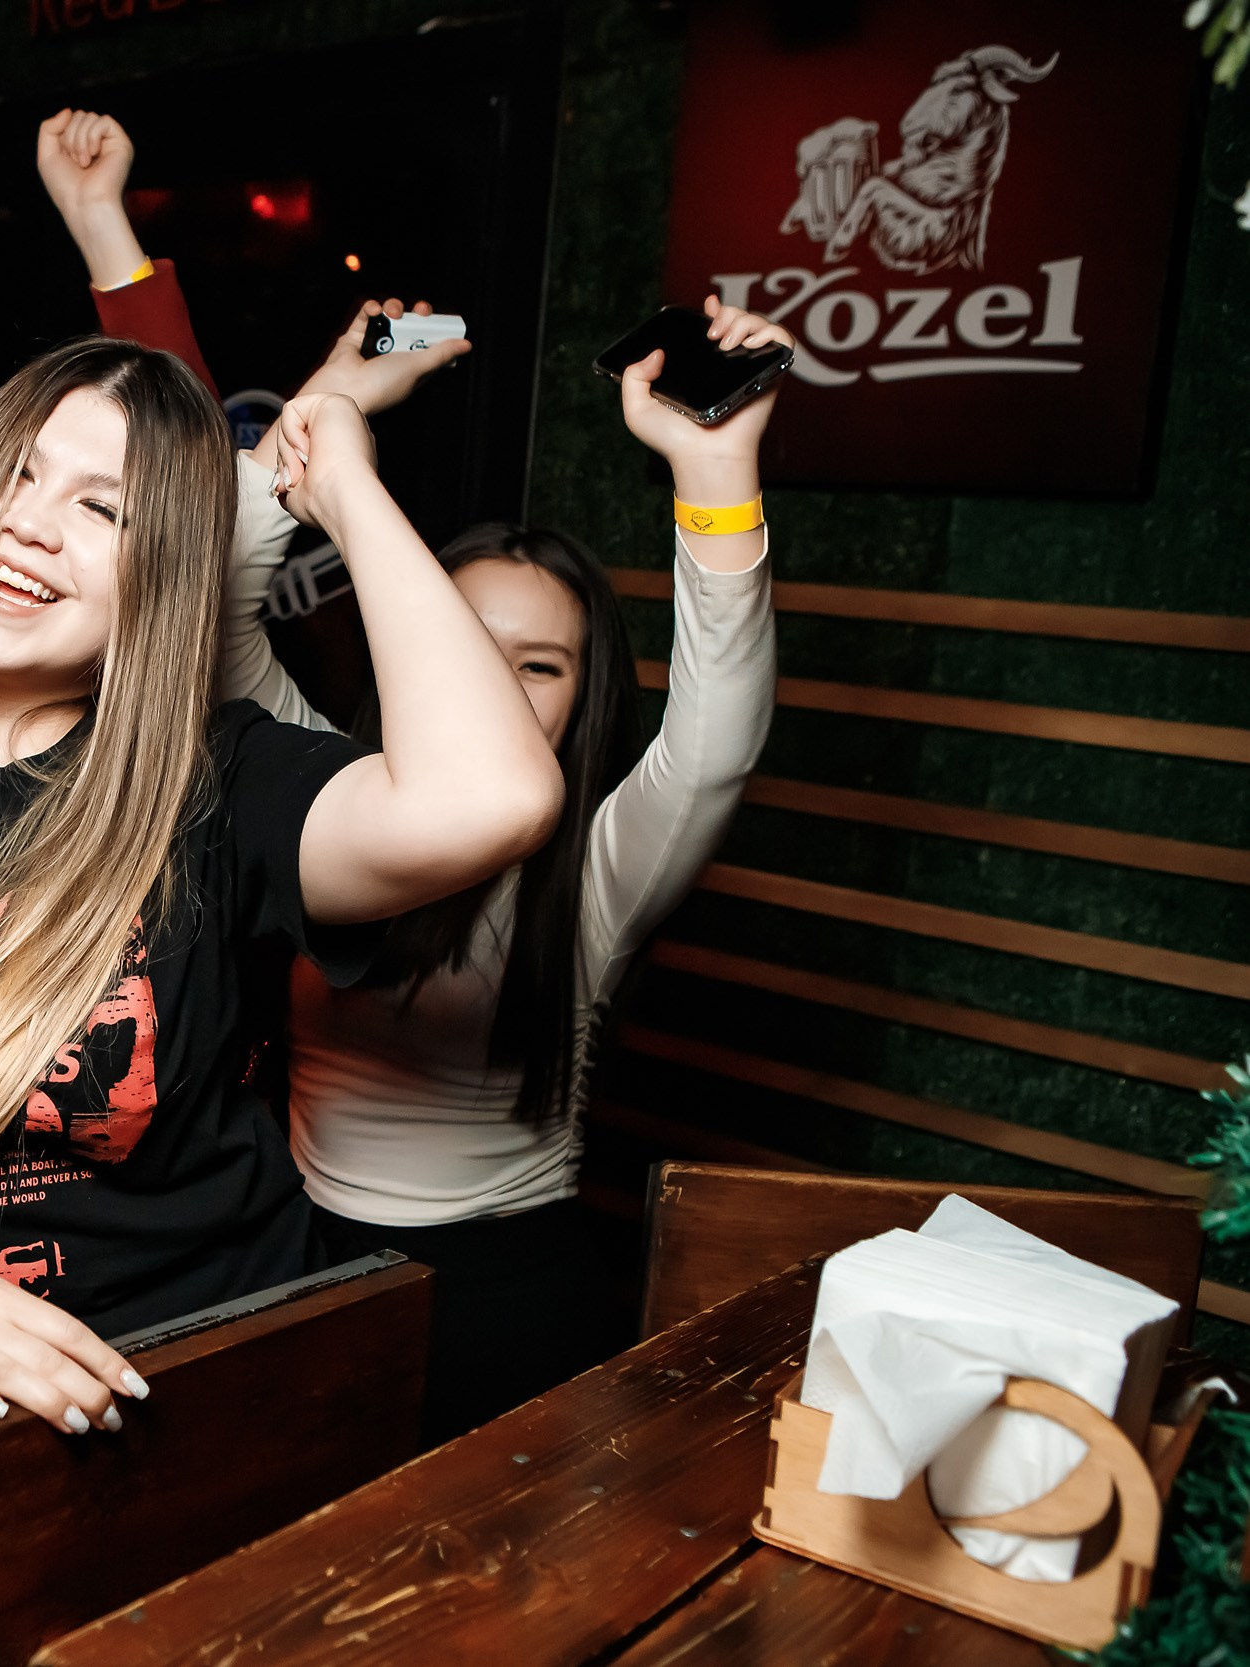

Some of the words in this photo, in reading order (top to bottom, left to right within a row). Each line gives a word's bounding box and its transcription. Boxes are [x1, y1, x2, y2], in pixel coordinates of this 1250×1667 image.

[711, 256, 1084, 387] Kozel
[19, 1177, 39, 1188] AND
[41, 1173, 71, 1185] NEVER
[72, 1171, 79, 1180] A
[11, 1191, 47, 1204] WORLD
